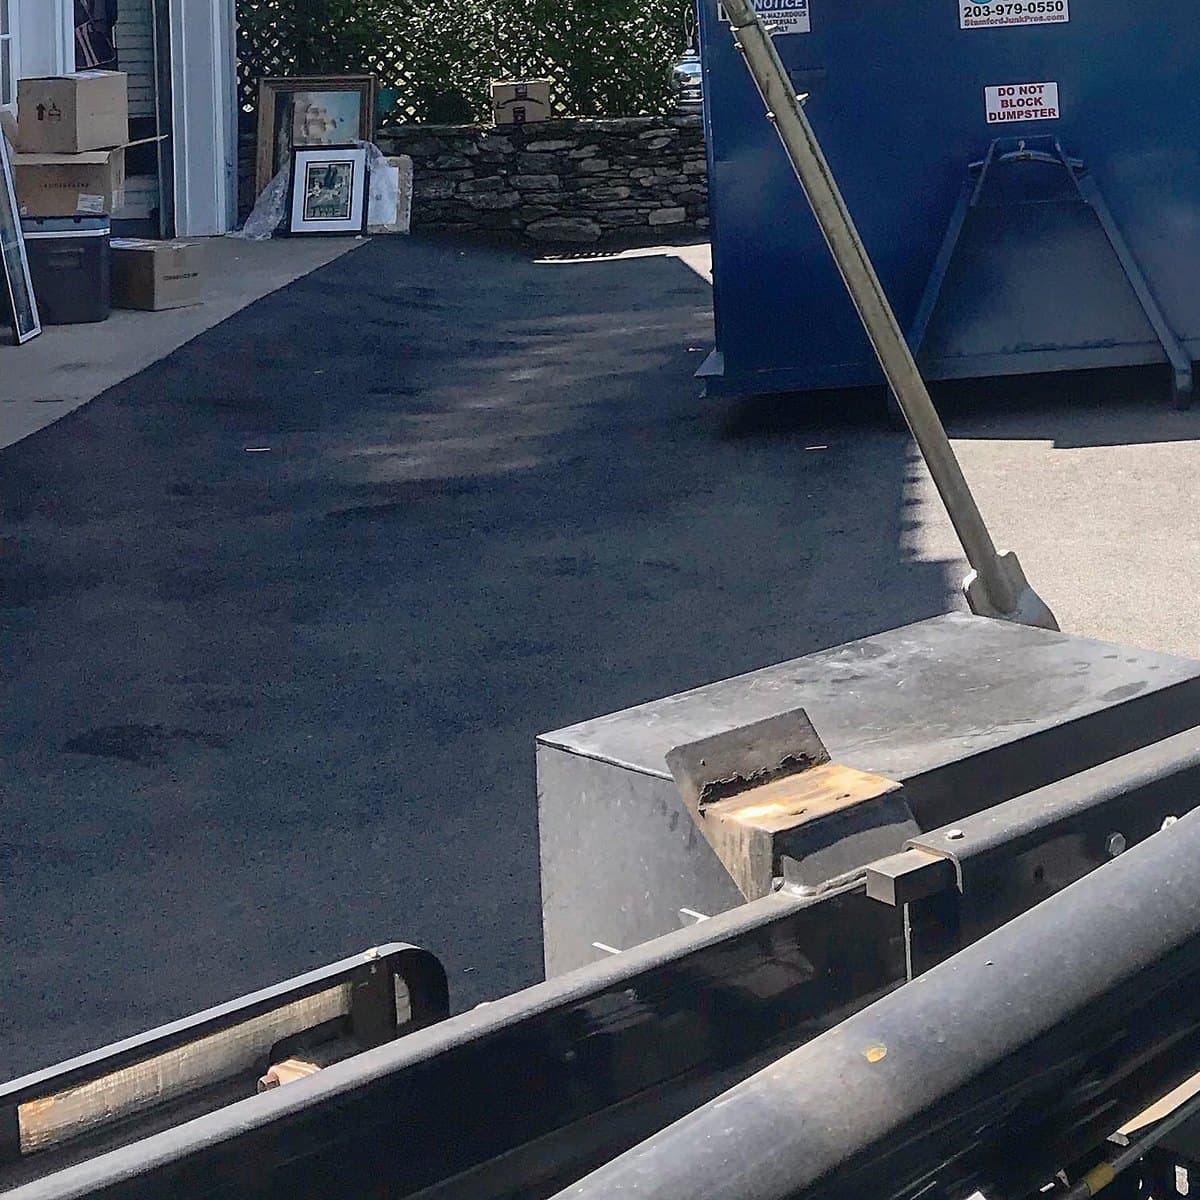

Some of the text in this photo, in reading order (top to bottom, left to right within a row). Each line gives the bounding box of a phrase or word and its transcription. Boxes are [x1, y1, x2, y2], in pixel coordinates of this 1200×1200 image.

[964, 1, 1064, 18] 203-979-0550
[964, 14, 1065, 27] StamfordJunkPros.com
[998, 85, 1044, 96] DO NOT
[1000, 97, 1043, 108] BLOCK
[988, 108, 1057, 121] DUMPSTER
